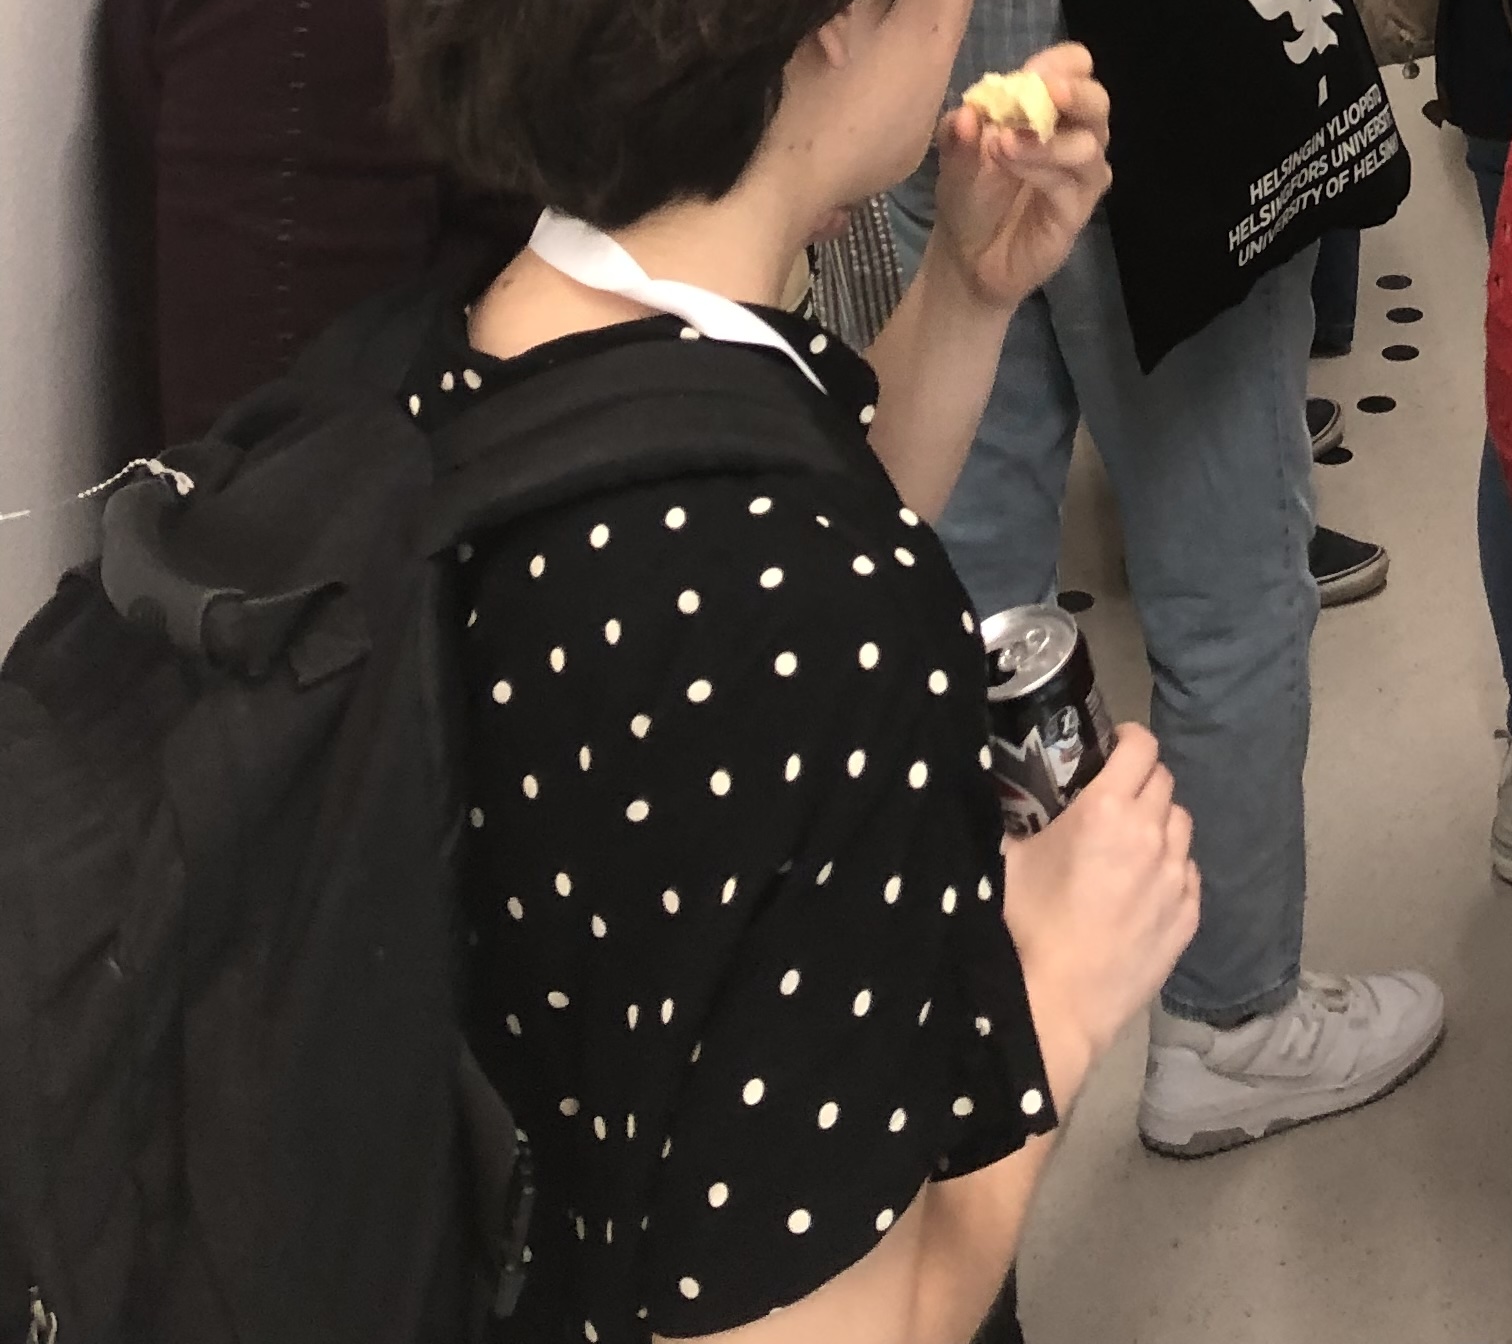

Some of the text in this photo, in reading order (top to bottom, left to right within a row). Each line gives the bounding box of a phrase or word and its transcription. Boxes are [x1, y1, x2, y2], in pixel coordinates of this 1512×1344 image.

[1228, 154, 1329, 253] HELSINGFORS
[1249, 126, 1325, 205] HELSINGIN
[1238, 183, 1324, 268] UNIVERSITY
[1325, 168, 1350, 199] OF
